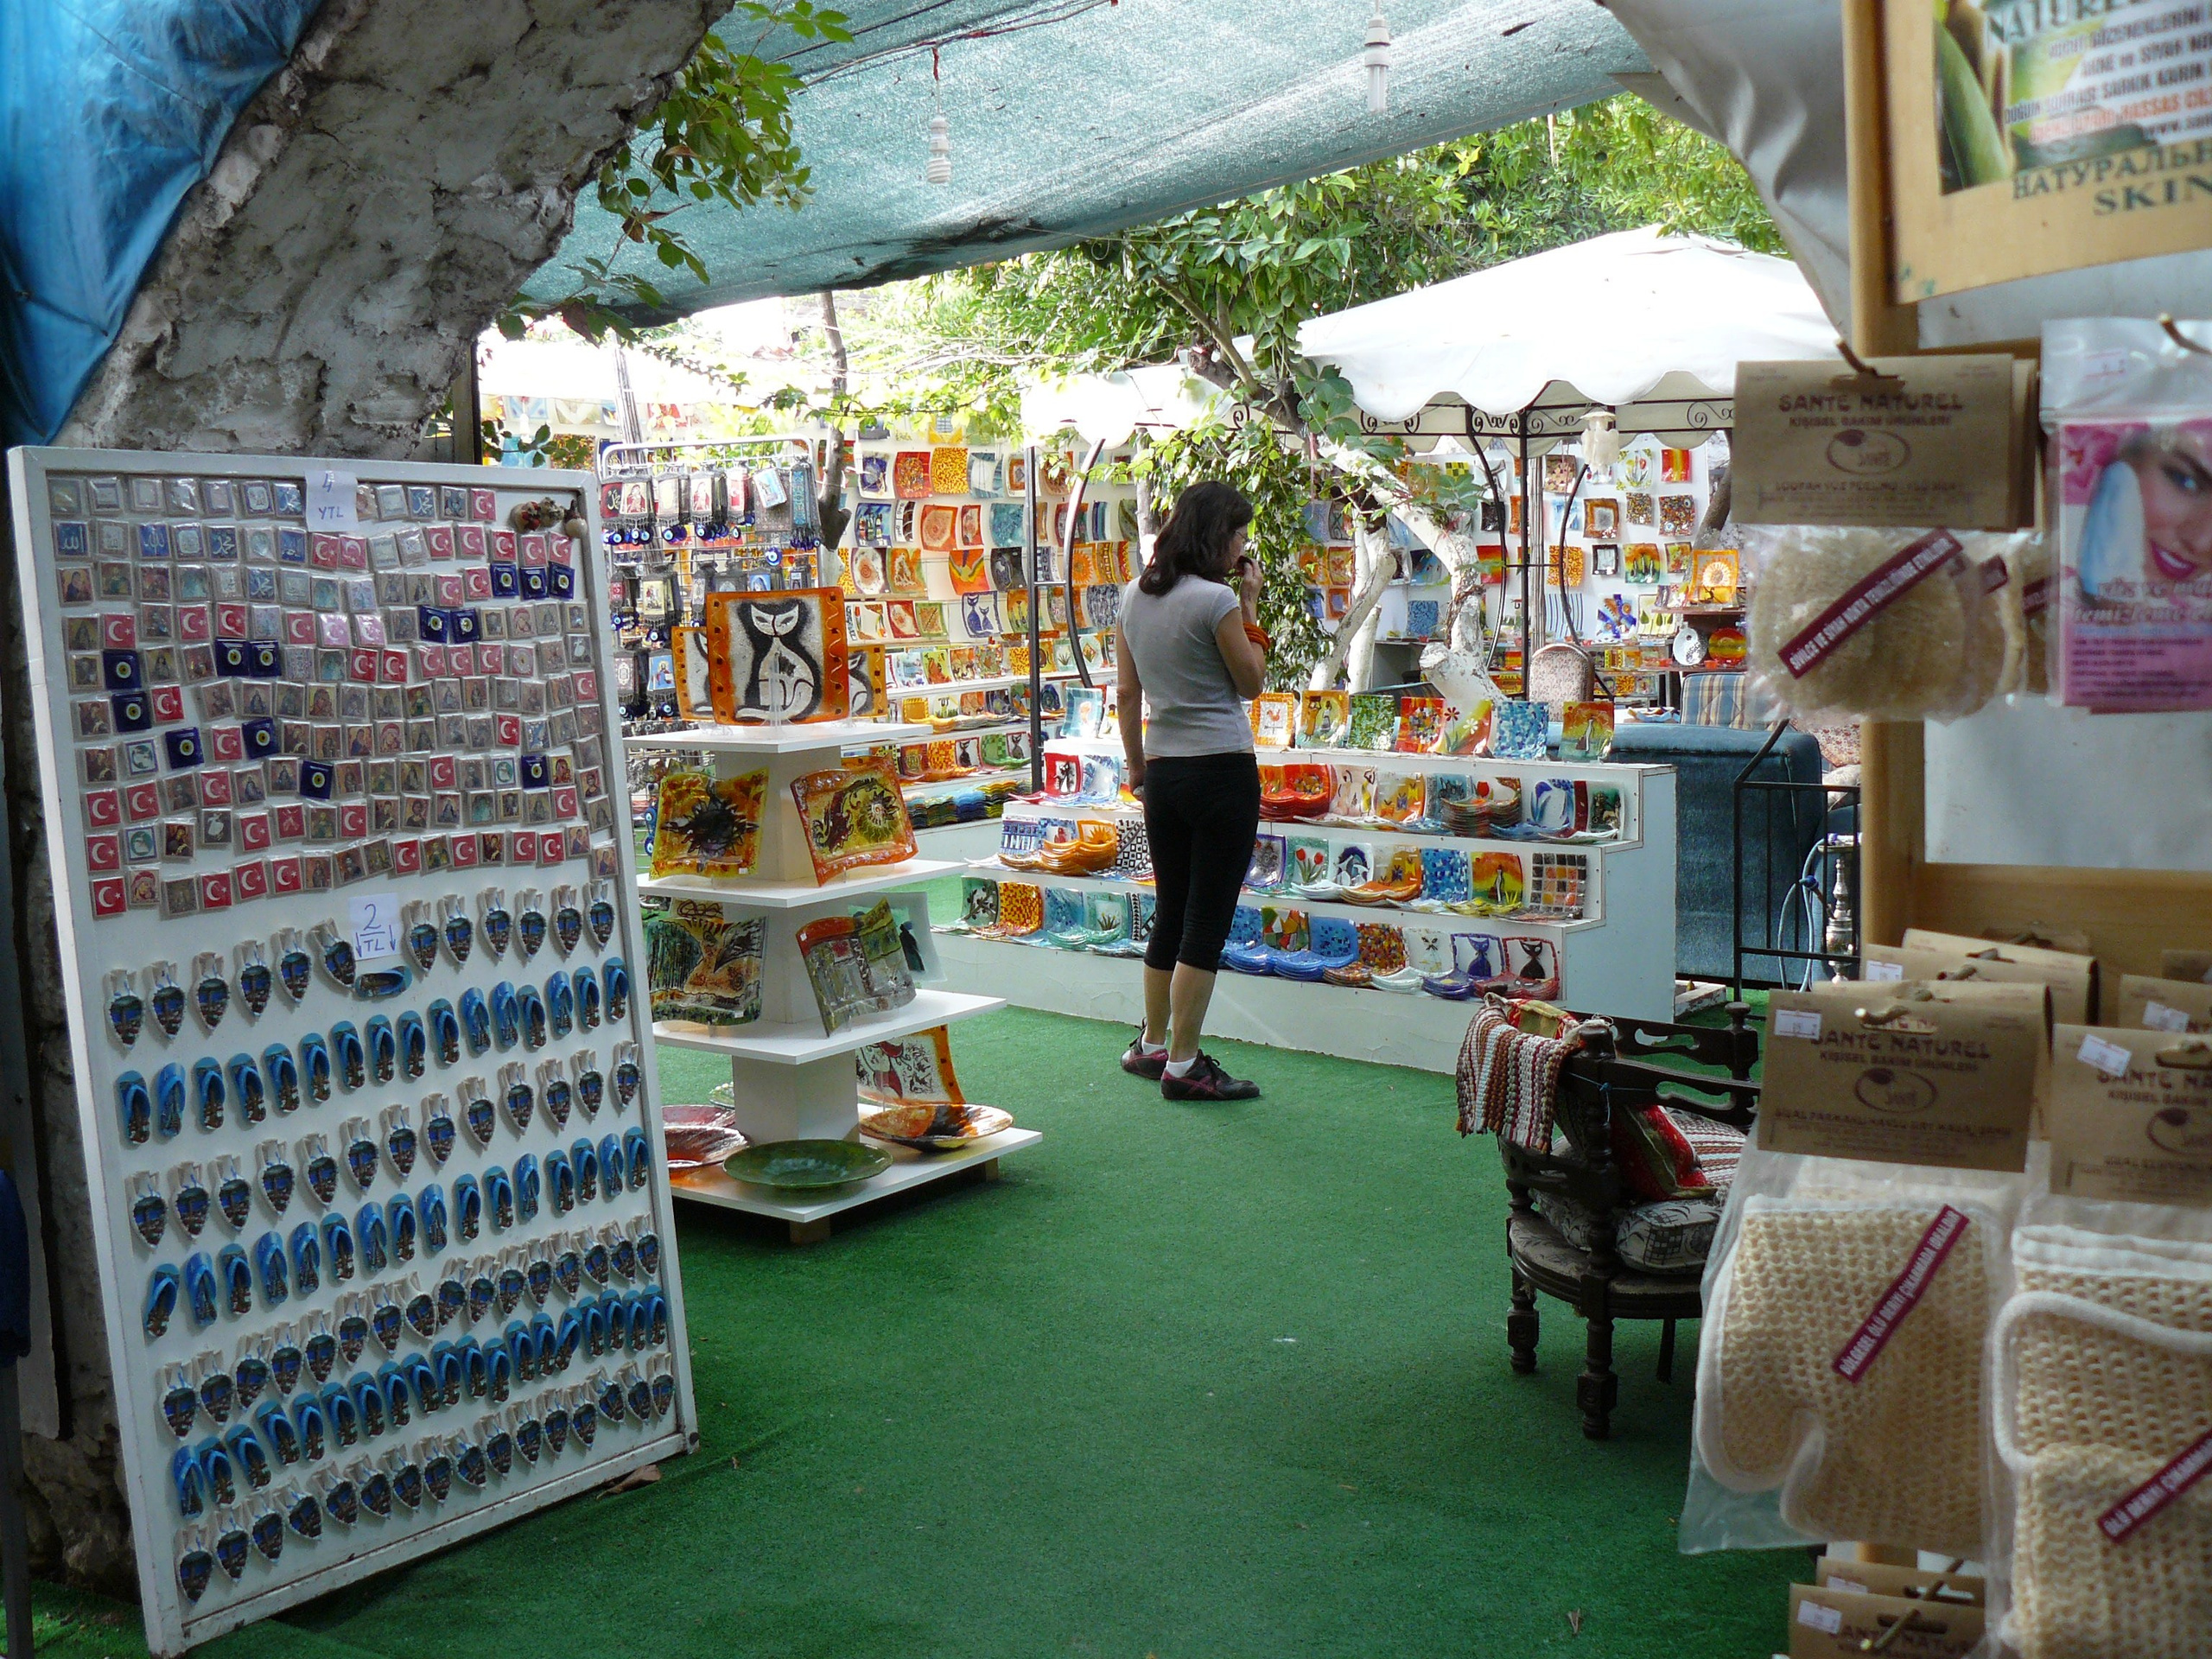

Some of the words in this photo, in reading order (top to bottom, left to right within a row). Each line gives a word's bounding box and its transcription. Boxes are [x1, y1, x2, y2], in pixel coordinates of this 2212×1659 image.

[1778, 394, 1851, 412] SANTE
[1859, 392, 1963, 411] NATUREL
[318, 506, 344, 520] YTL
[363, 903, 382, 931] 2
[363, 938, 385, 952] TL
[1890, 1036, 1991, 1059] NATUREL
